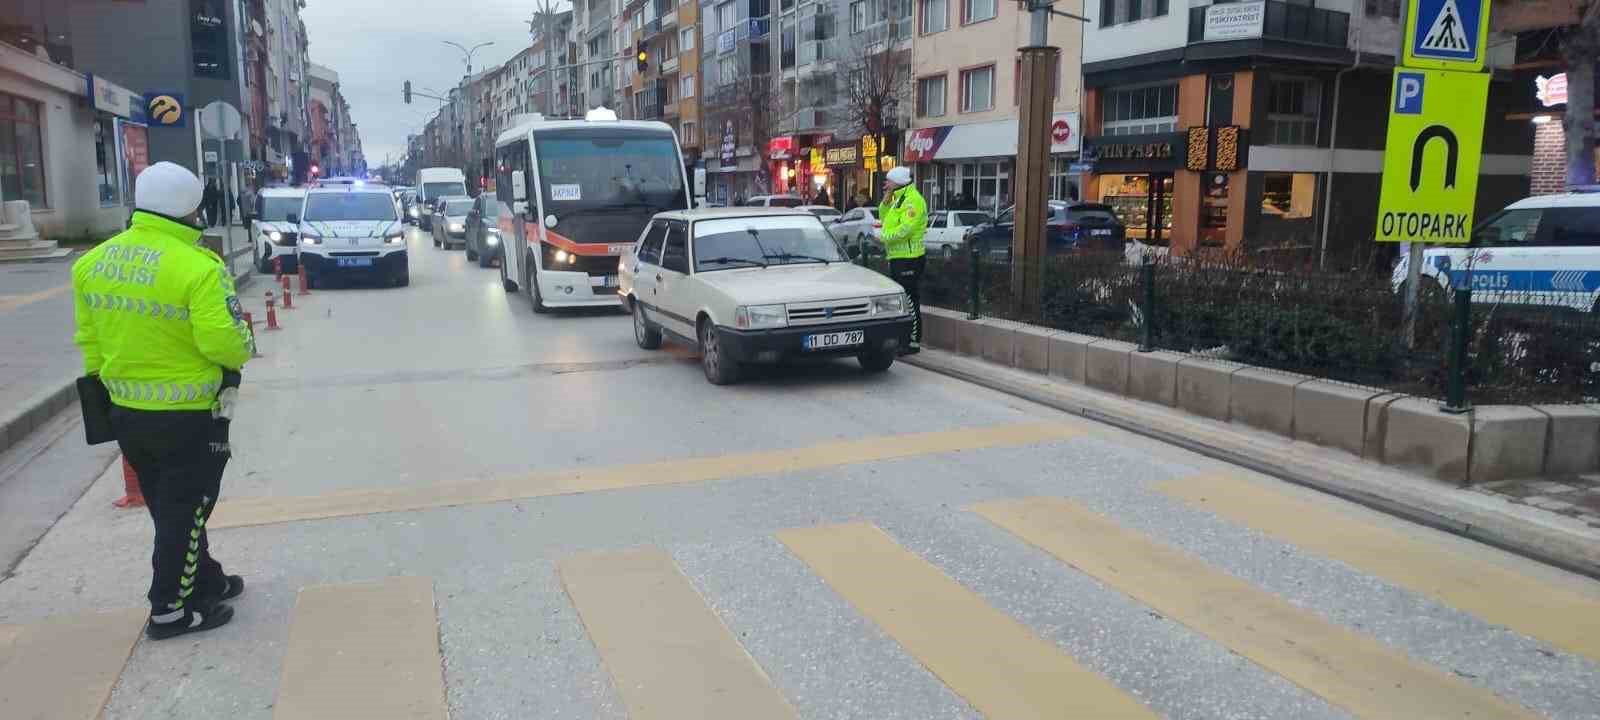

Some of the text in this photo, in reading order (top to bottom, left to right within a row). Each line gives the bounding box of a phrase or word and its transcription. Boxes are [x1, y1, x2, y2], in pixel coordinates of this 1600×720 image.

[1399, 78, 1420, 109] P
[1382, 212, 1468, 238] OTOPARK
[1471, 271, 1509, 289] POLİS
[810, 334, 818, 347] 11
[844, 331, 864, 344] 787
